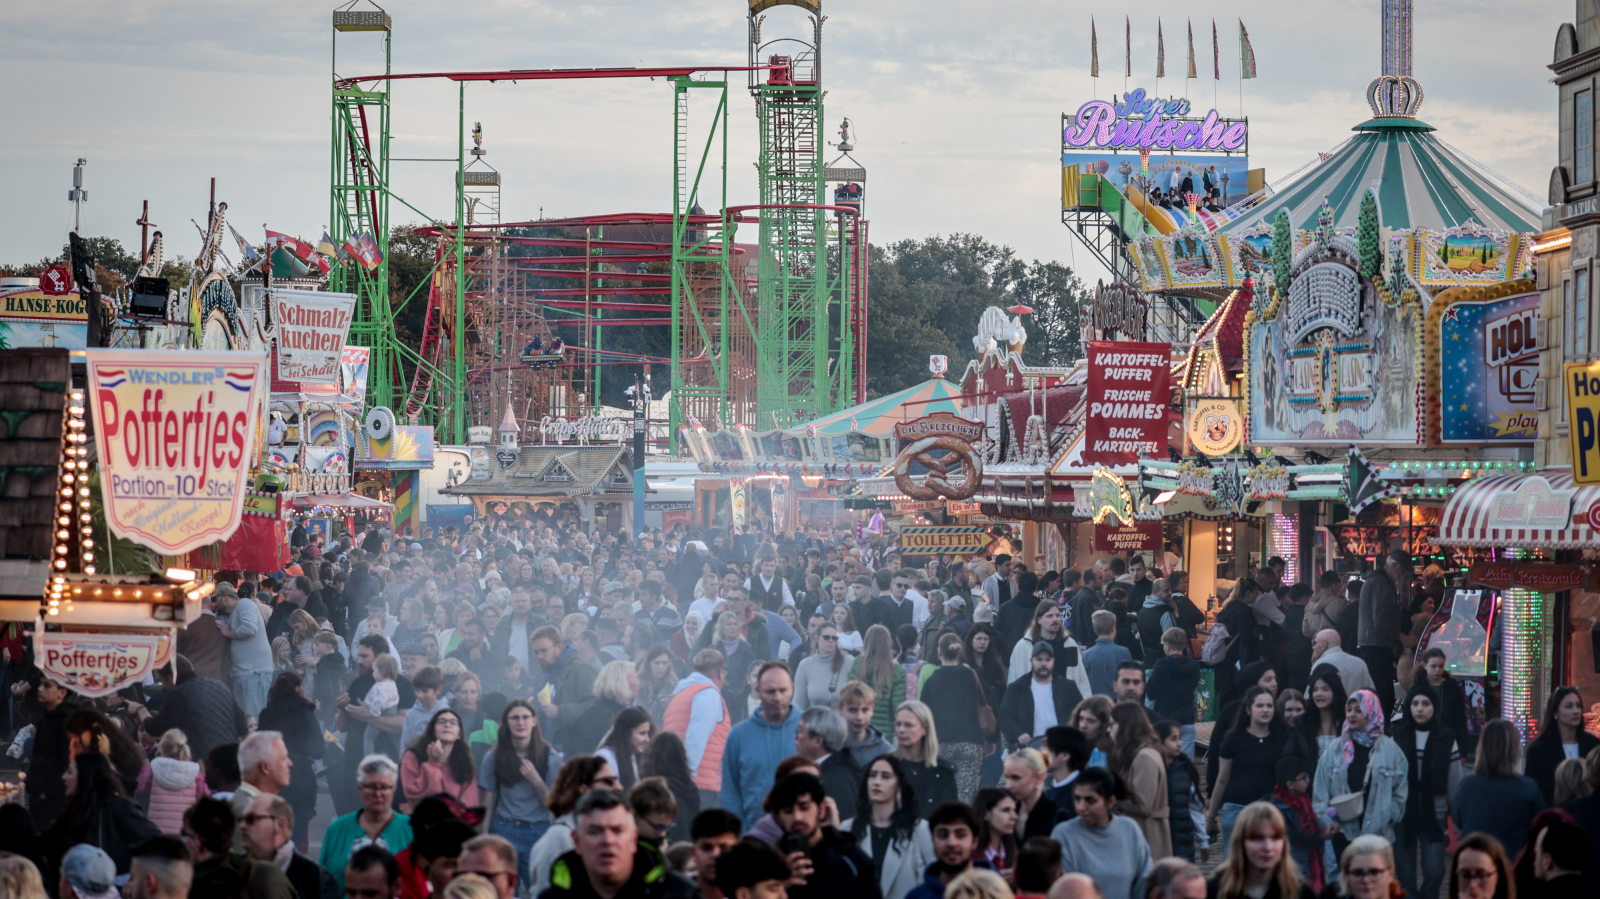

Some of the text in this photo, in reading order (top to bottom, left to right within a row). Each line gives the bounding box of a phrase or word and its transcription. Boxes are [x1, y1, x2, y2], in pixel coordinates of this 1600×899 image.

[1115, 88, 1191, 121] Super
[1064, 100, 1247, 149] Rutsche
[279, 302, 350, 329] Schmalz-
[281, 327, 342, 352] kuchen
[1491, 315, 1540, 361] HOL
[1094, 353, 1169, 367] KARTOFFEL-
[288, 369, 300, 379] bei
[1104, 368, 1153, 381] PUFFER
[1104, 390, 1151, 401] FRISCHE
[1090, 402, 1165, 419] POMMES
[1193, 406, 1210, 432] KARTOFFEL
[901, 424, 918, 435] DIE
[1109, 427, 1145, 440] BACK-
[98, 388, 248, 490] Poffertjes
[1576, 407, 1600, 478] P
[1093, 440, 1159, 453] KARTOFFEL
[925, 501, 935, 509] Eis
[953, 503, 962, 511] Eis
[964, 502, 976, 510] we
[905, 533, 983, 547] TOILETTEN
[1107, 533, 1150, 542] KARTOFFEL-
[1114, 541, 1143, 549] PUFFER
[47, 650, 138, 673] Poffertjes
